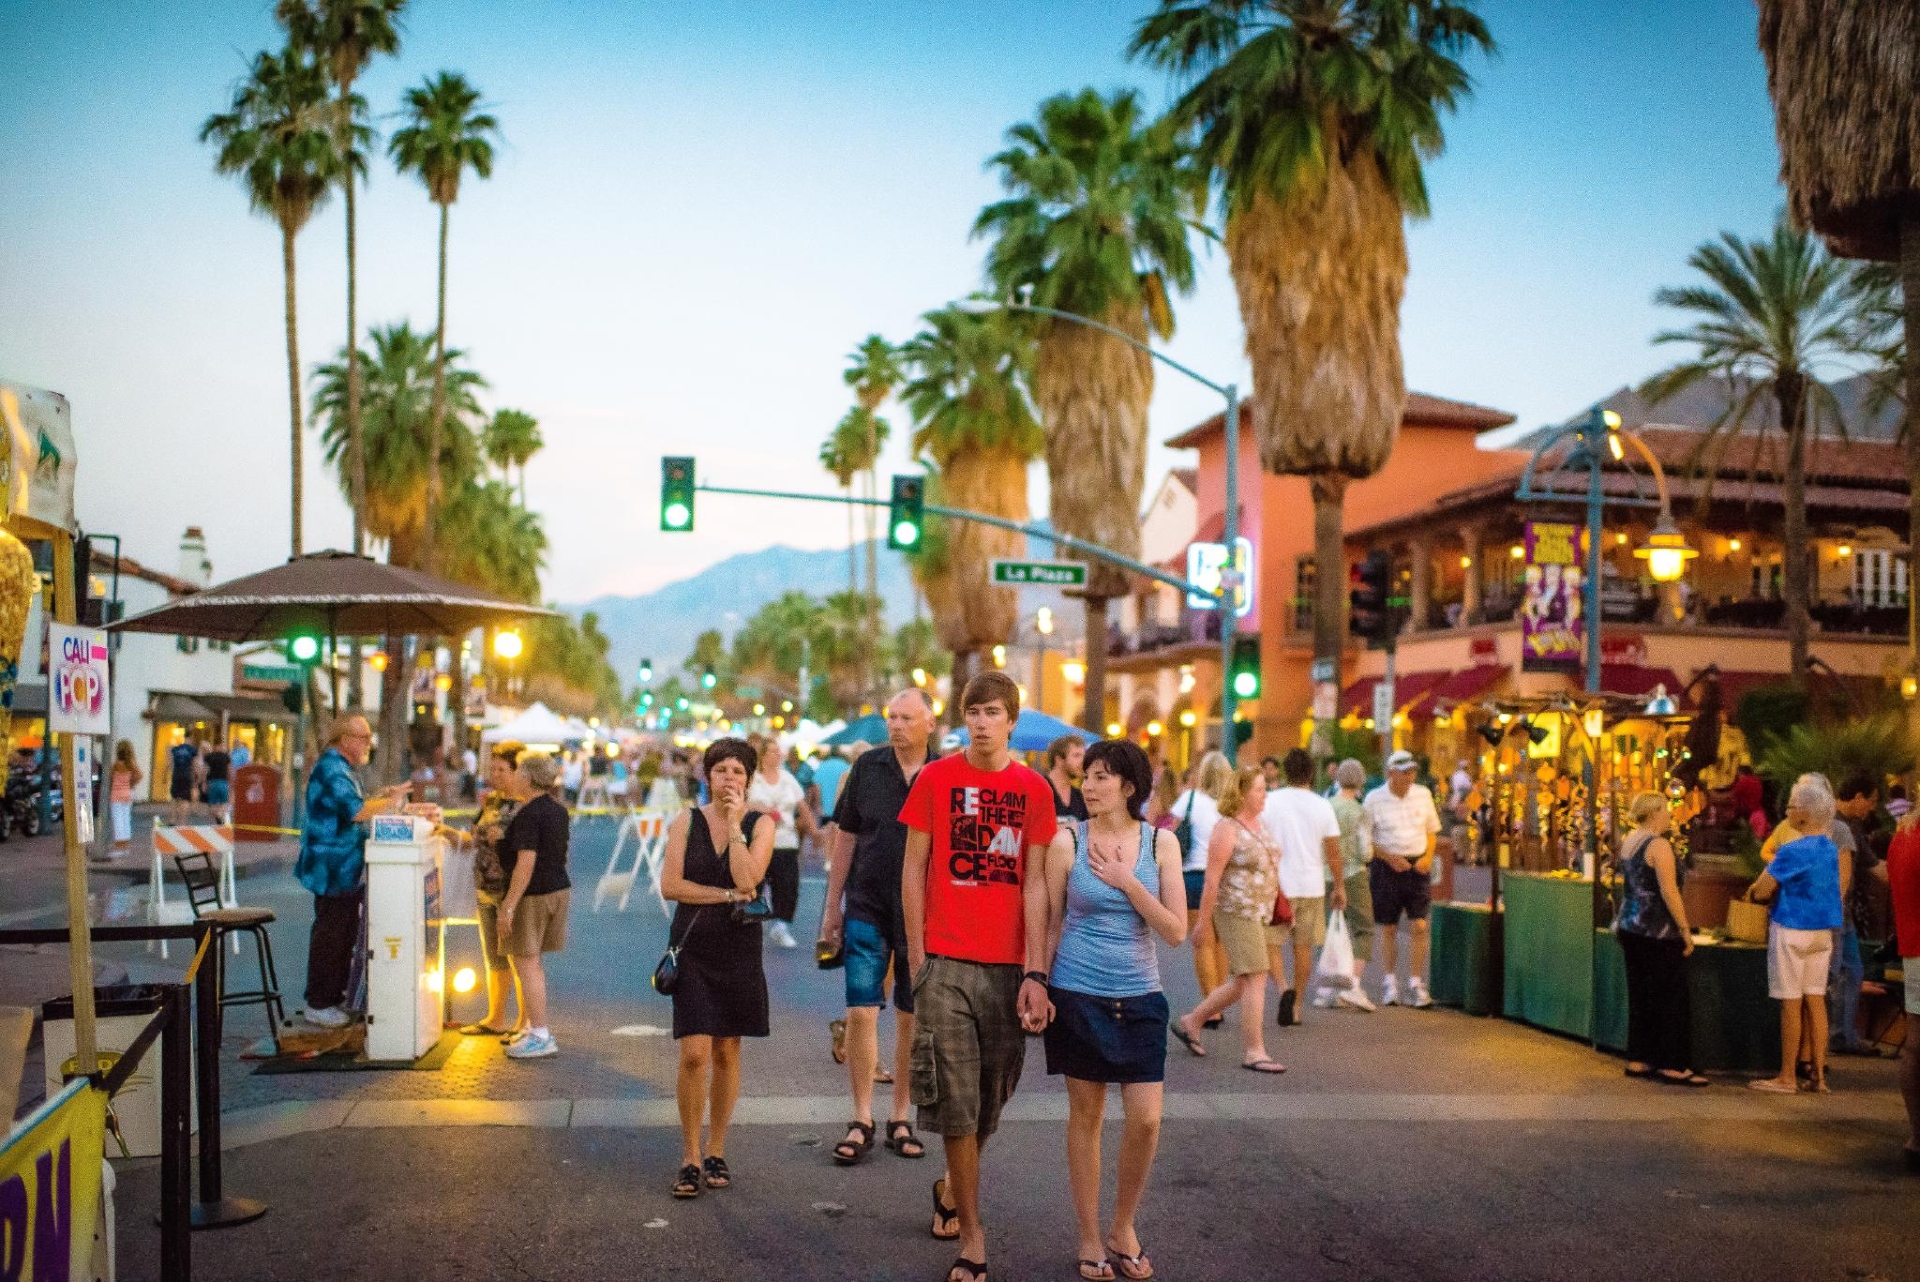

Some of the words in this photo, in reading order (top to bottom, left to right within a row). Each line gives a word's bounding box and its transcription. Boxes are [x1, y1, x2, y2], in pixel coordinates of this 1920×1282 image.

[63, 636, 89, 665] CALI
[61, 666, 99, 714] POP
[950, 786, 1026, 814] RECLAIM
[980, 806, 1007, 826] THE
